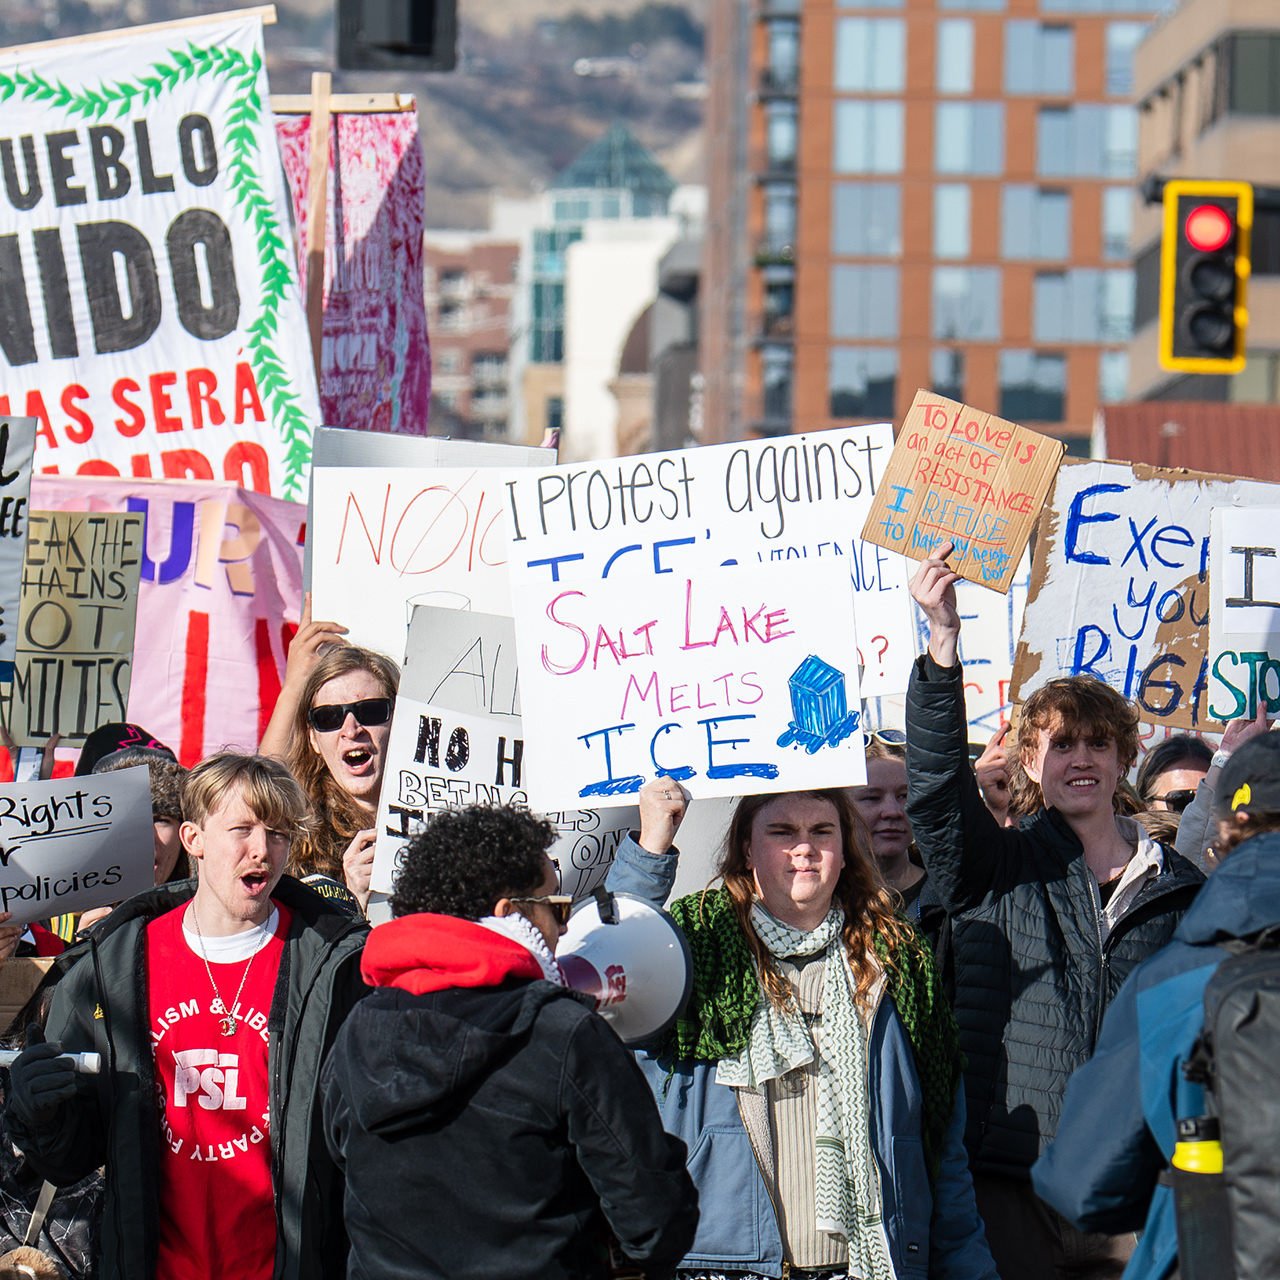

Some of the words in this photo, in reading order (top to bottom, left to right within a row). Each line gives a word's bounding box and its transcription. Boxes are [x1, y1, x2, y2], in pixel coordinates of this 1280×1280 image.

[934, 443, 965, 464] act
[505, 480, 527, 541] I
[536, 456, 696, 537] Protest
[725, 434, 883, 540] against
[914, 457, 1036, 515] RESISTANCE
[879, 514, 906, 542] to
[885, 484, 915, 514] I
[922, 490, 1011, 543] REFUSE
[89, 516, 140, 567] THE
[981, 557, 1009, 582] bor
[540, 590, 659, 676] SALT
[679, 578, 796, 651] LAKE
[621, 669, 765, 721] MELTS
[413, 714, 470, 773] NO
[577, 714, 781, 799] ICE
[0, 863, 123, 913] policies
[173, 1064, 248, 1111] PSL
[190, 1125, 265, 1162] PARTY
